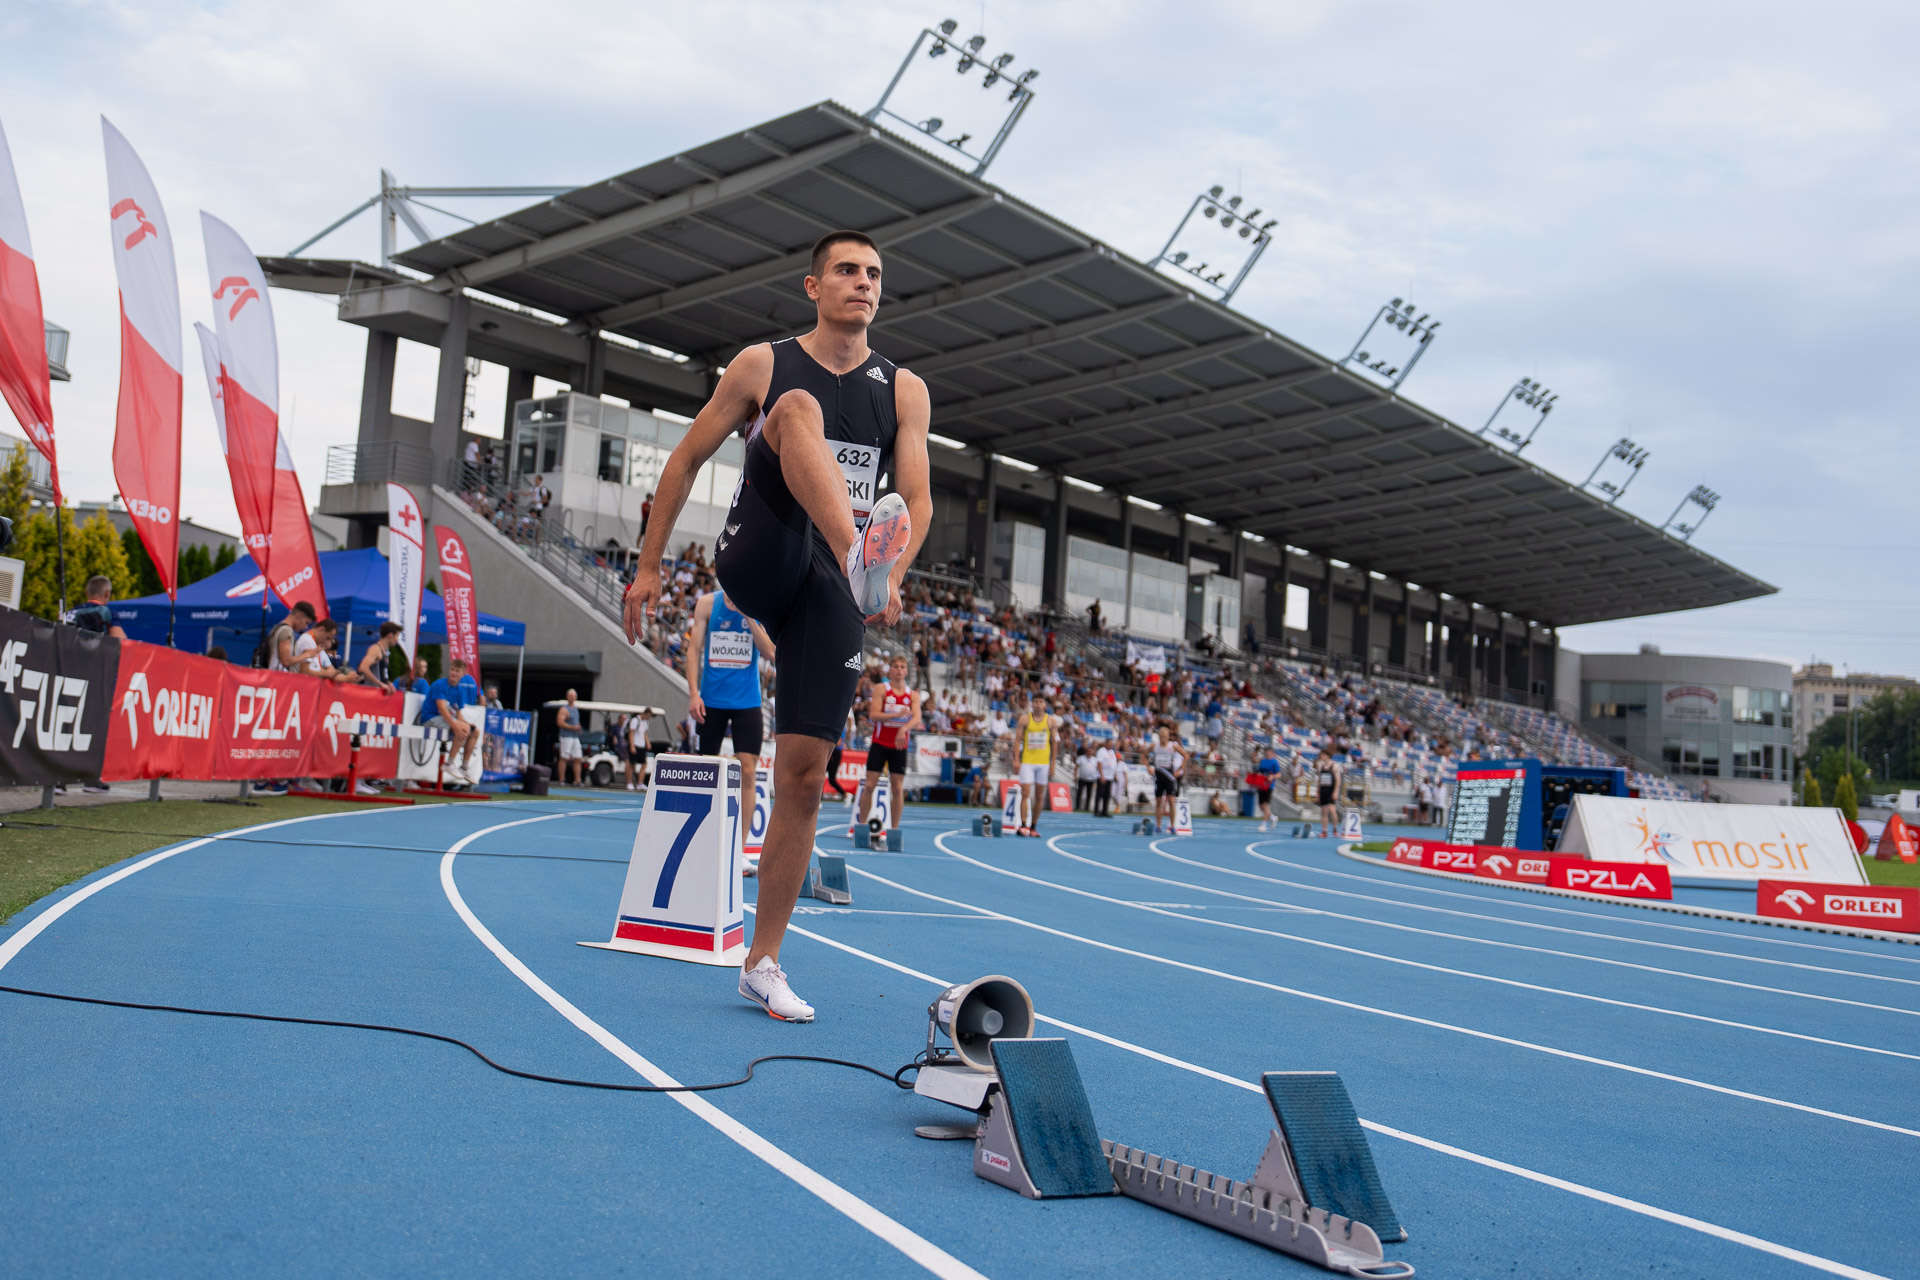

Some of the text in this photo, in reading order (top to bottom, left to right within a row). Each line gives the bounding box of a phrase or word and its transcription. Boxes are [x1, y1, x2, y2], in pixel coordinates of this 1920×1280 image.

[836, 448, 871, 468] 632
[712, 645, 751, 656] WÓJCIAK
[733, 635, 750, 643] 212
[12, 669, 93, 751] FUEL
[153, 688, 213, 740] ORLEN
[233, 685, 301, 741] PZLA
[660, 769, 714, 781] RADOM 2024
[750, 785, 766, 838] 6
[877, 790, 887, 823] 5
[1006, 797, 1015, 822] 4
[1180, 804, 1189, 826] 3
[1349, 814, 1359, 832] 2
[653, 790, 713, 909] 7
[1692, 833, 1809, 870] mosir
[1566, 868, 1657, 891] PZLA
[1830, 899, 1897, 914] ORLEN
